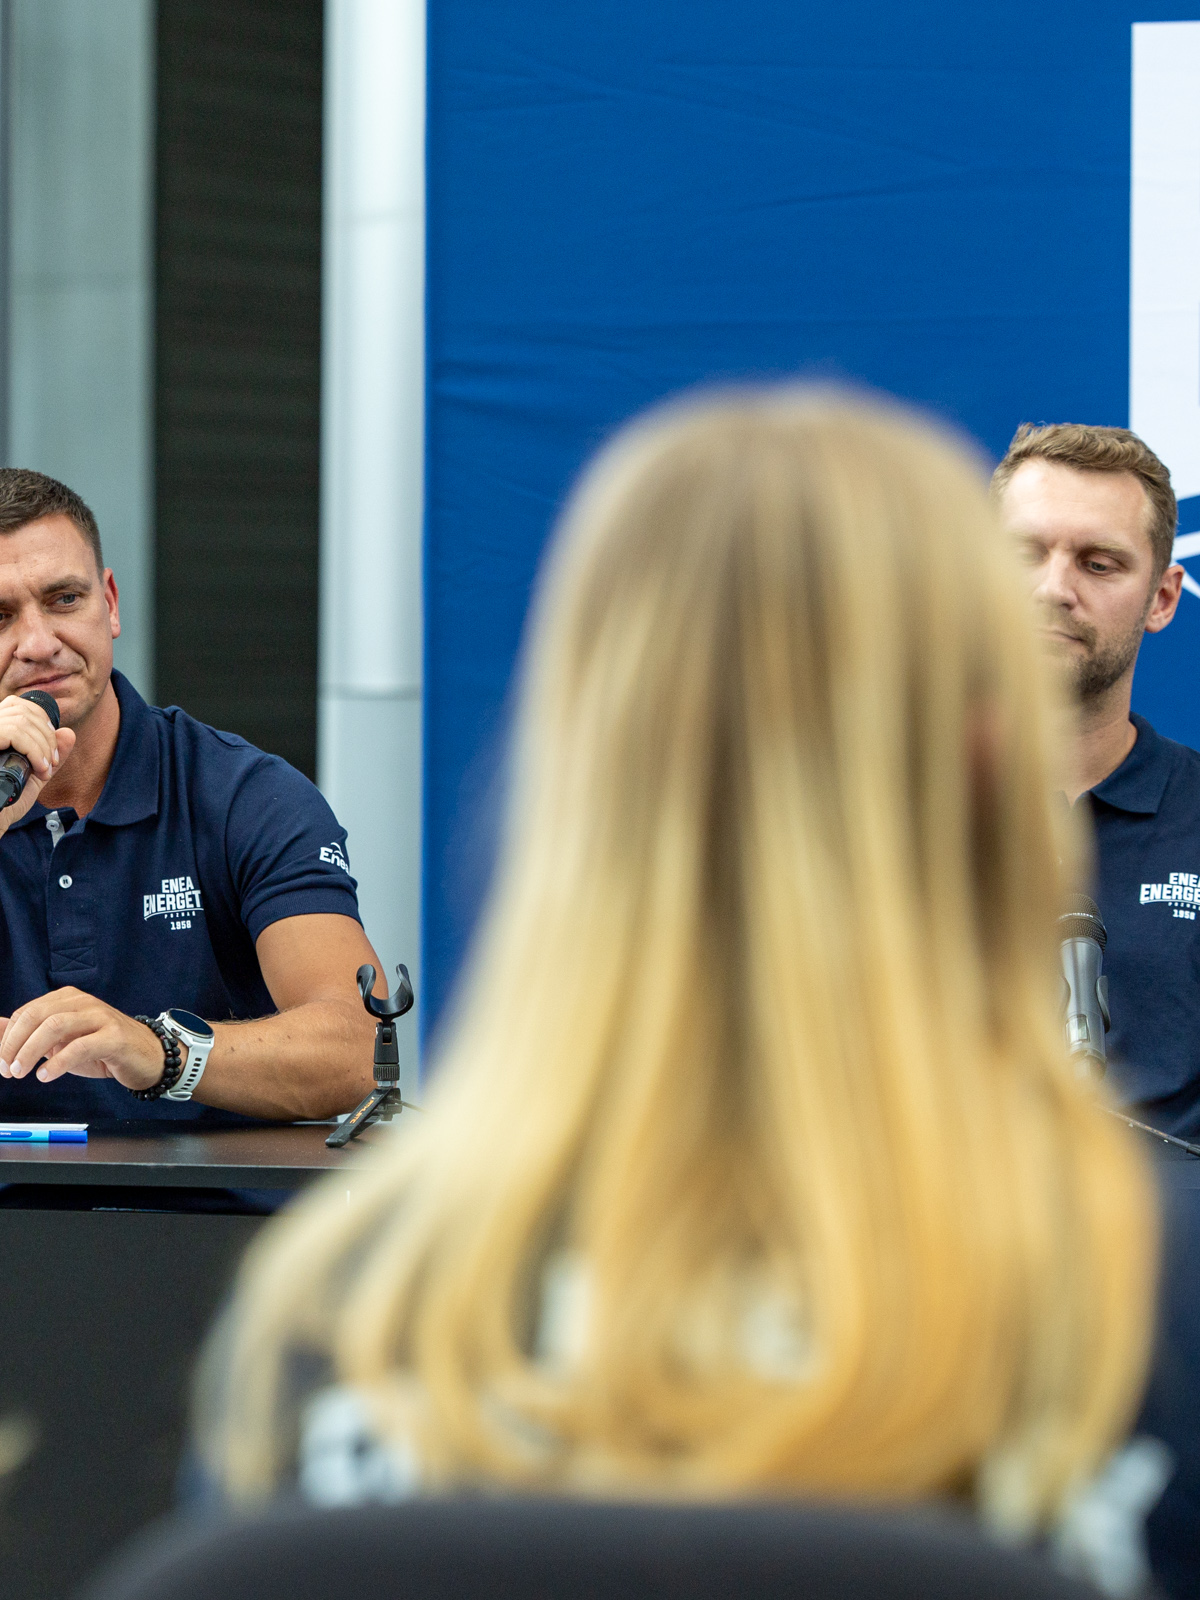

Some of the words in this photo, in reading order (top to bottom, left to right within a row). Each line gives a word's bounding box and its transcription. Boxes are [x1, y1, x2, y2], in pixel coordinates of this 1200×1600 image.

[161, 876, 195, 894] ENEA
[1169, 872, 1200, 889] ENE
[170, 920, 192, 931] 1958
